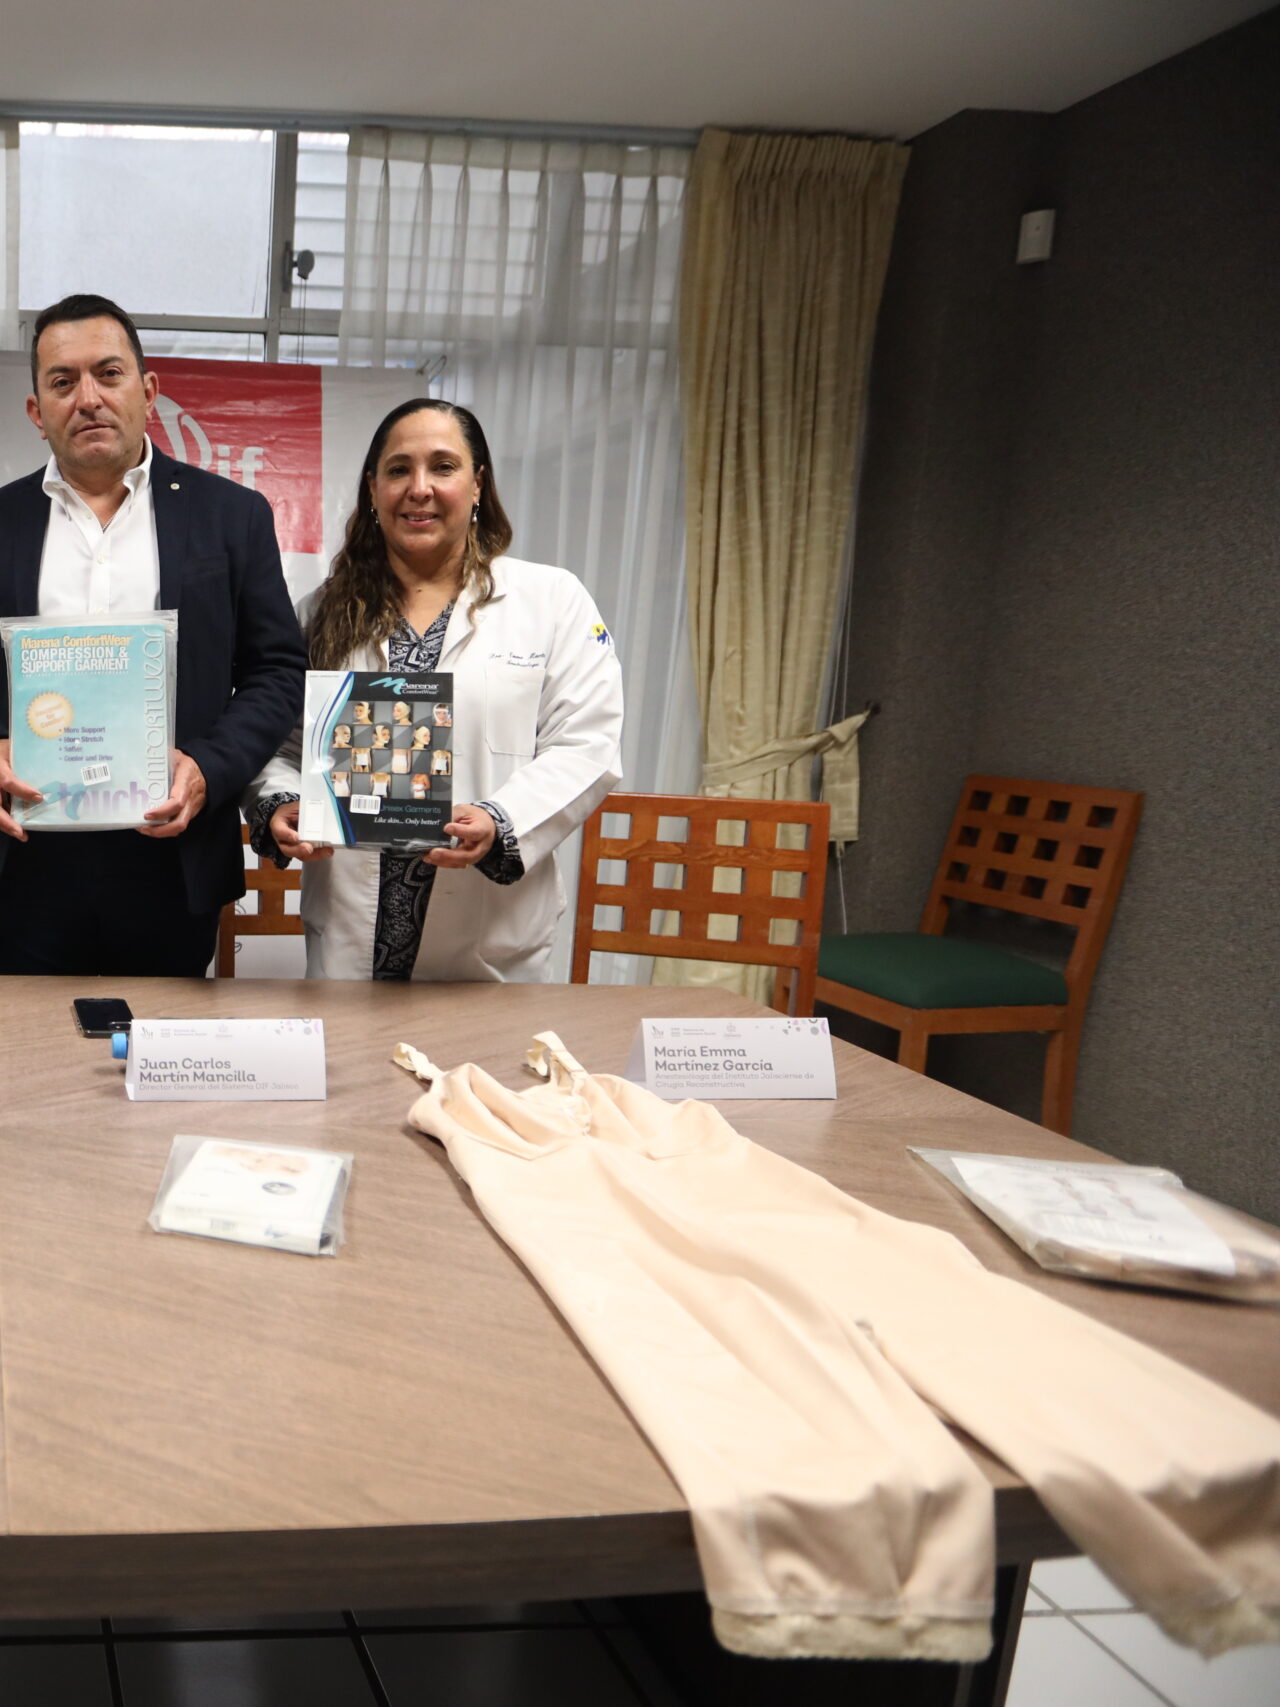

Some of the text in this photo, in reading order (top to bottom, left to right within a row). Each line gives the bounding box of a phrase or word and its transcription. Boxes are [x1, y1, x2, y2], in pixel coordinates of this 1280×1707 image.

[21, 634, 130, 649] Marena ComfortWear
[21, 646, 128, 661] COMPRESSION &
[21, 659, 72, 674] SUPPORT
[74, 657, 130, 672] GARMENT
[81, 726, 106, 735] Support
[58, 781, 149, 814] touch
[404, 804, 442, 813] Garments
[374, 816, 387, 824] Like
[405, 818, 420, 826] Only
[700, 1045, 747, 1057] Emma
[139, 1057, 231, 1070] Juan Carlos
[655, 1060, 720, 1072] Martínez
[140, 1070, 257, 1083] Martín Mancilla
[139, 1083, 171, 1091] Director
[173, 1083, 206, 1091] General
[255, 1082, 269, 1090] DIF
